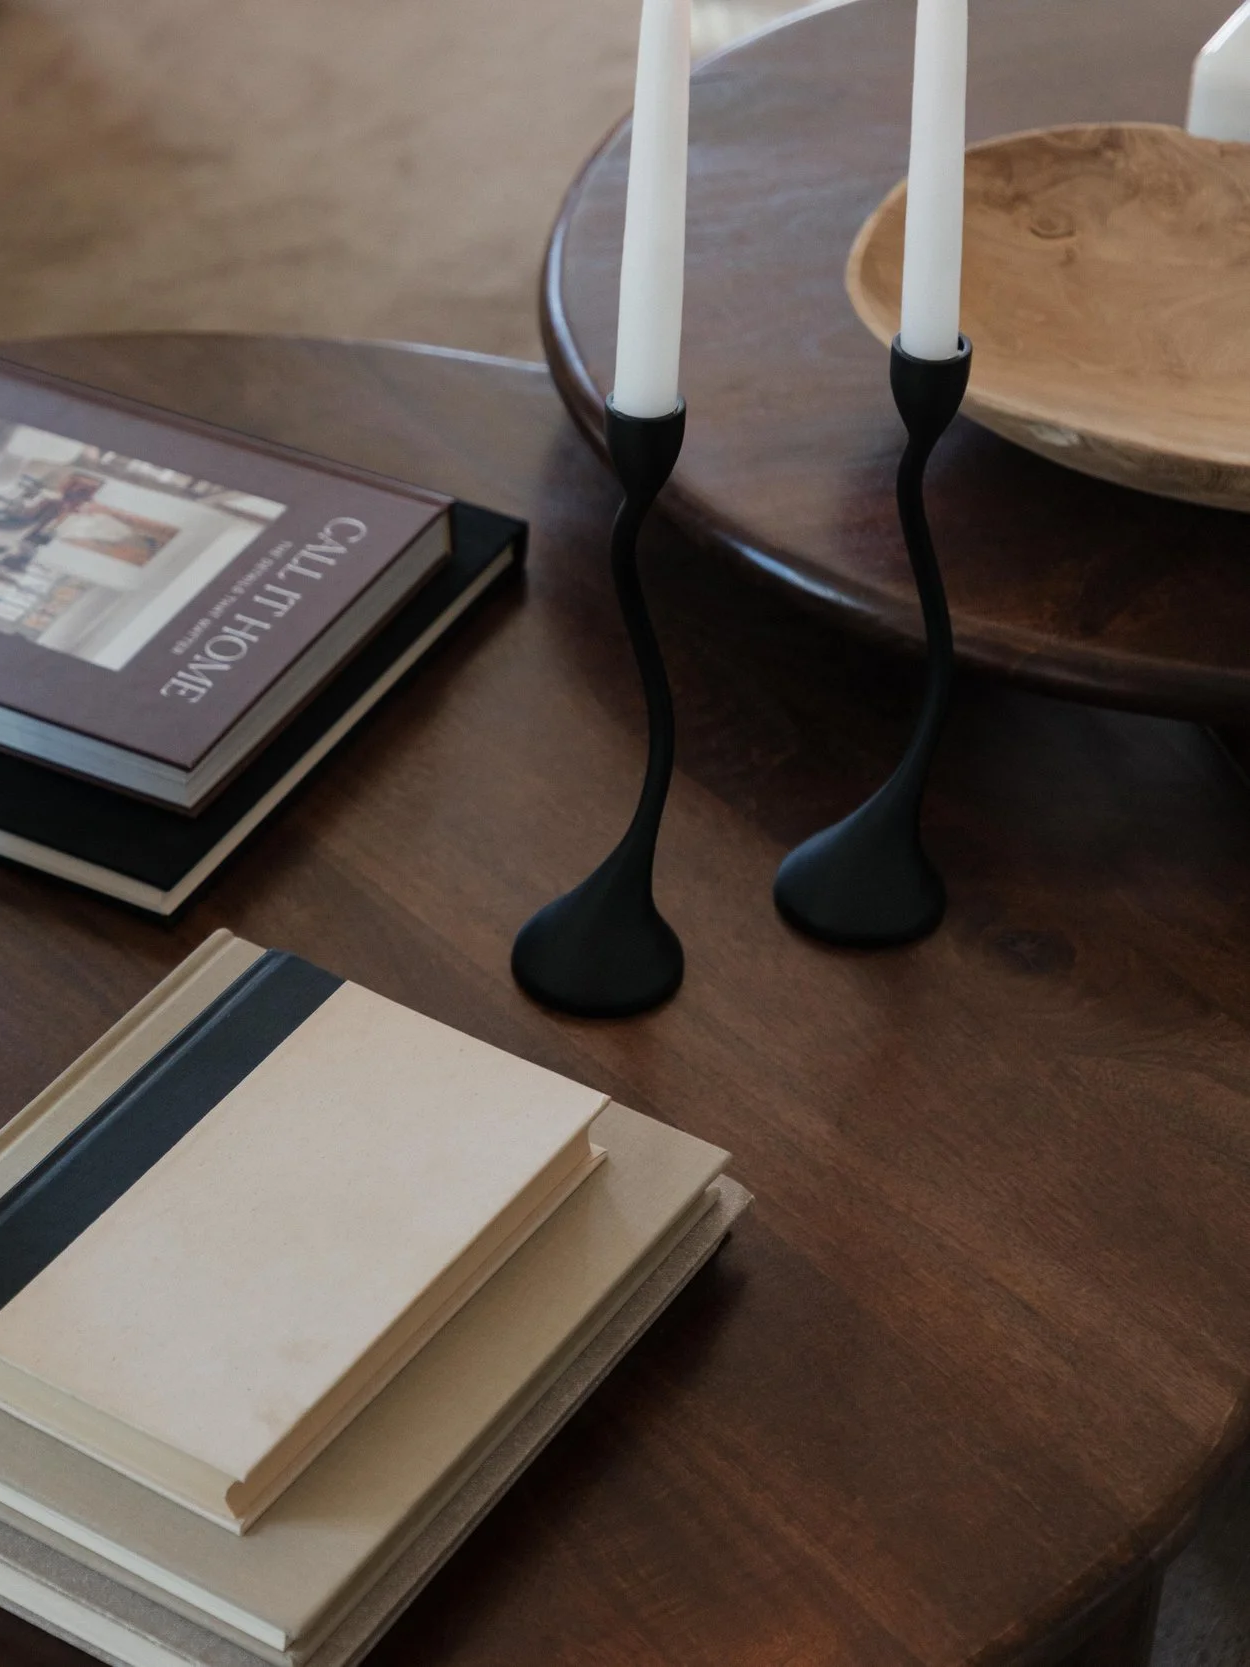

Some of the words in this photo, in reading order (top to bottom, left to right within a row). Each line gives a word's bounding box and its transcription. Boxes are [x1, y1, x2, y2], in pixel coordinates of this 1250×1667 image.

[269, 540, 294, 559] THE
[277, 516, 368, 580] CALL
[209, 594, 238, 619] THAT
[253, 583, 301, 618] IT
[171, 617, 212, 655] MATTER
[160, 613, 272, 703] HOME
